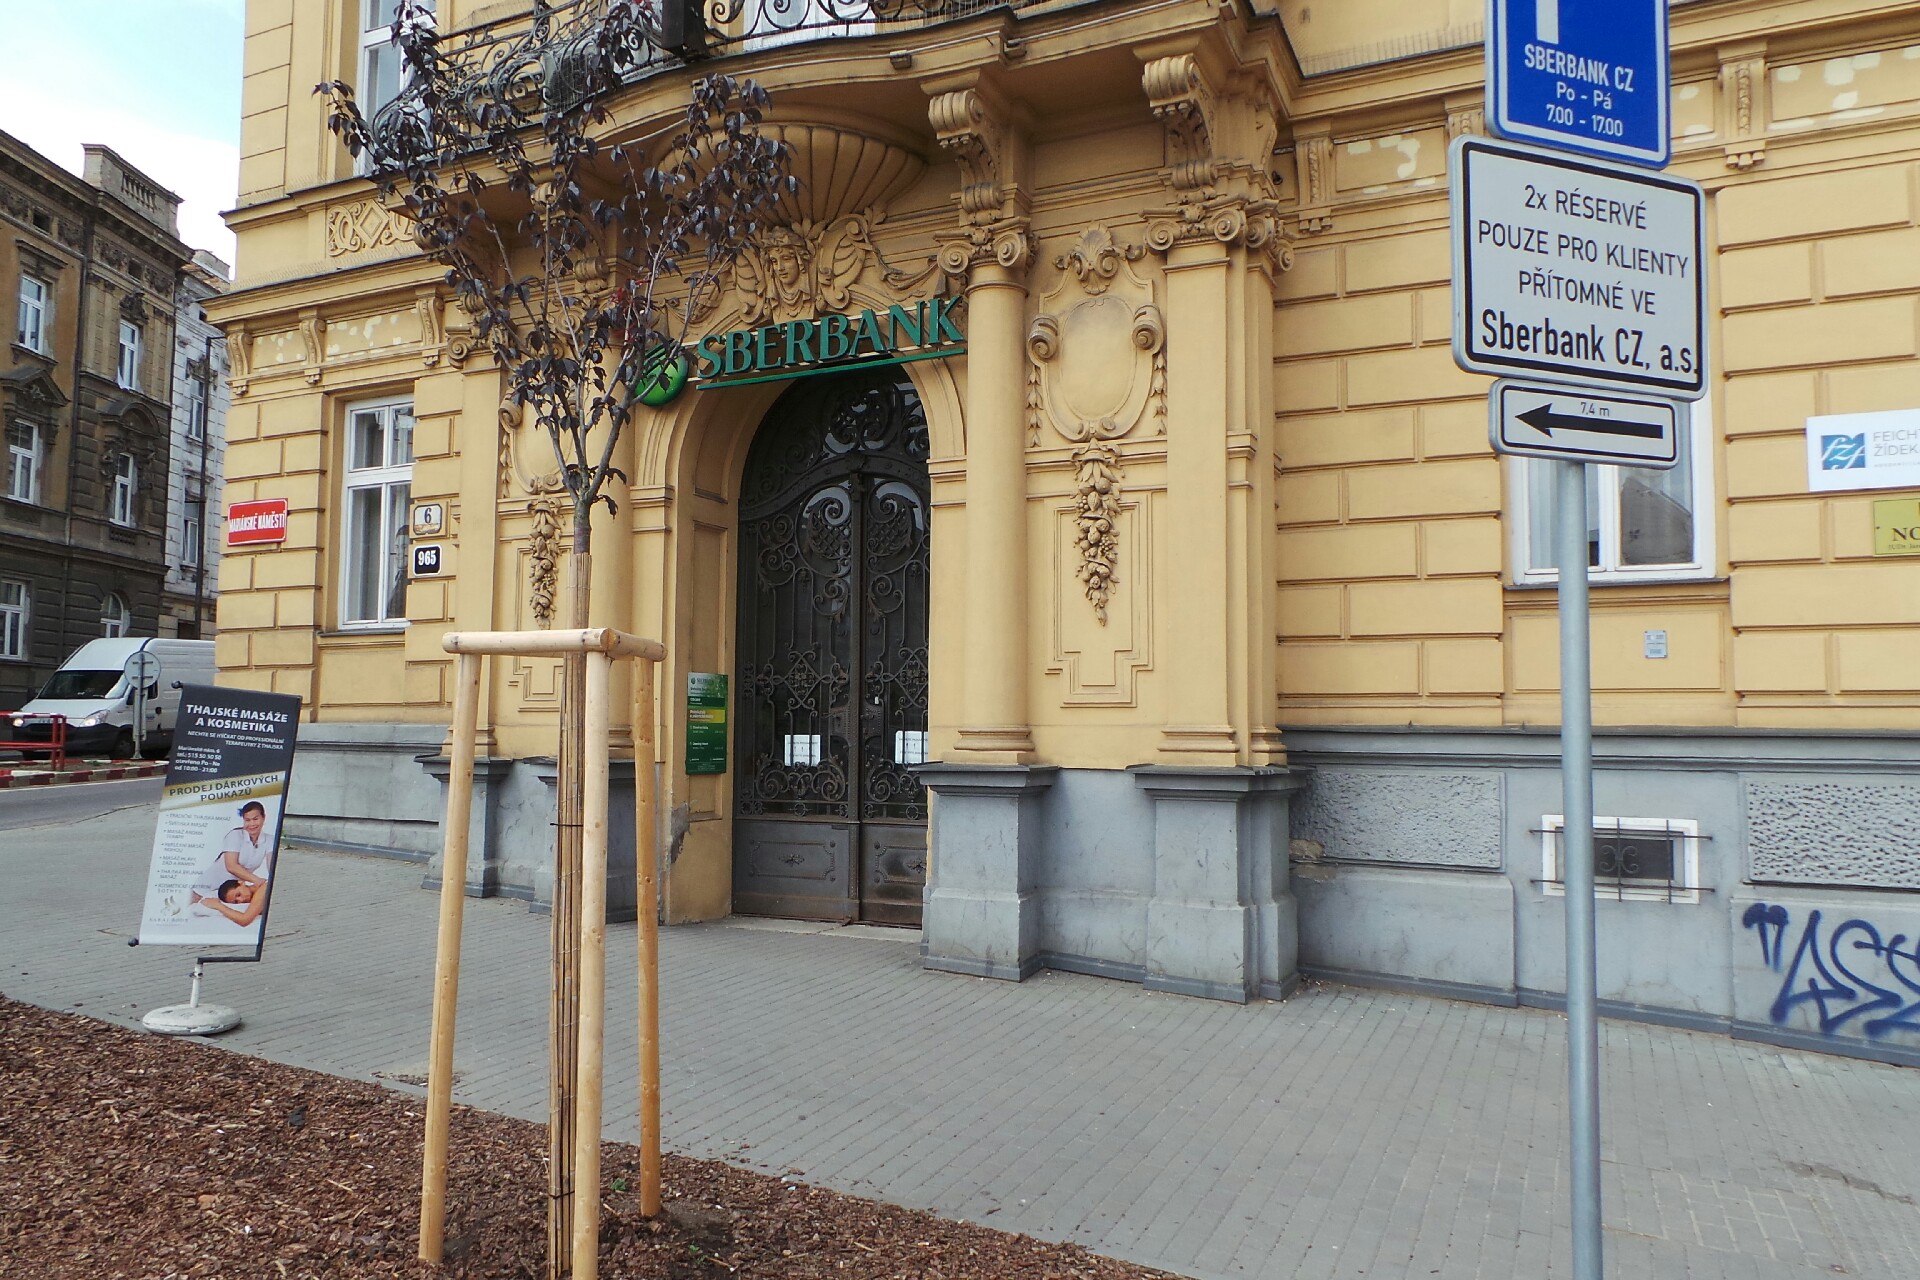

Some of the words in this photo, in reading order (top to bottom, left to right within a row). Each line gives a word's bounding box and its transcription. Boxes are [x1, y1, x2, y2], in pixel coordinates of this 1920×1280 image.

[1524, 43, 1610, 87] SBERBANK
[1614, 67, 1634, 93] CZ
[1556, 82, 1575, 102] Po
[1593, 87, 1612, 111] Pá
[1546, 103, 1574, 127] 7.00
[1591, 113, 1624, 138] 17.00
[1524, 184, 1548, 212] 2x
[1555, 187, 1648, 231] RÉSERVÉ
[1479, 219, 1550, 256] POUZE
[1558, 233, 1598, 264] PRO
[1606, 243, 1688, 279] KLIENTY
[1519, 266, 1624, 311] PŘÍTOMNÉ
[1631, 288, 1657, 316] VE
[696, 295, 965, 380] SBERBANK
[1482, 307, 1606, 364] Sberbank
[1615, 327, 1651, 371] CZ,
[1660, 342, 1699, 376] a.s.
[1580, 401, 1595, 416] 7.4
[1599, 405, 1611, 417] m
[1873, 428, 1920, 443] FEICH
[257, 509, 287, 530] NÁMĚSTÍ
[424, 507, 432, 524] 6
[418, 549, 437, 566] 965
[186, 704, 239, 718] THAJSKÉ
[240, 709, 288, 723] MASÁŽE
[195, 717, 205, 726] A
[207, 718, 275, 733] KOSMETIKA
[169, 784, 213, 796] PRODEJ
[215, 774, 278, 790] DÁRKOVÝCH
[200, 788, 252, 801] POUKAZŮ
